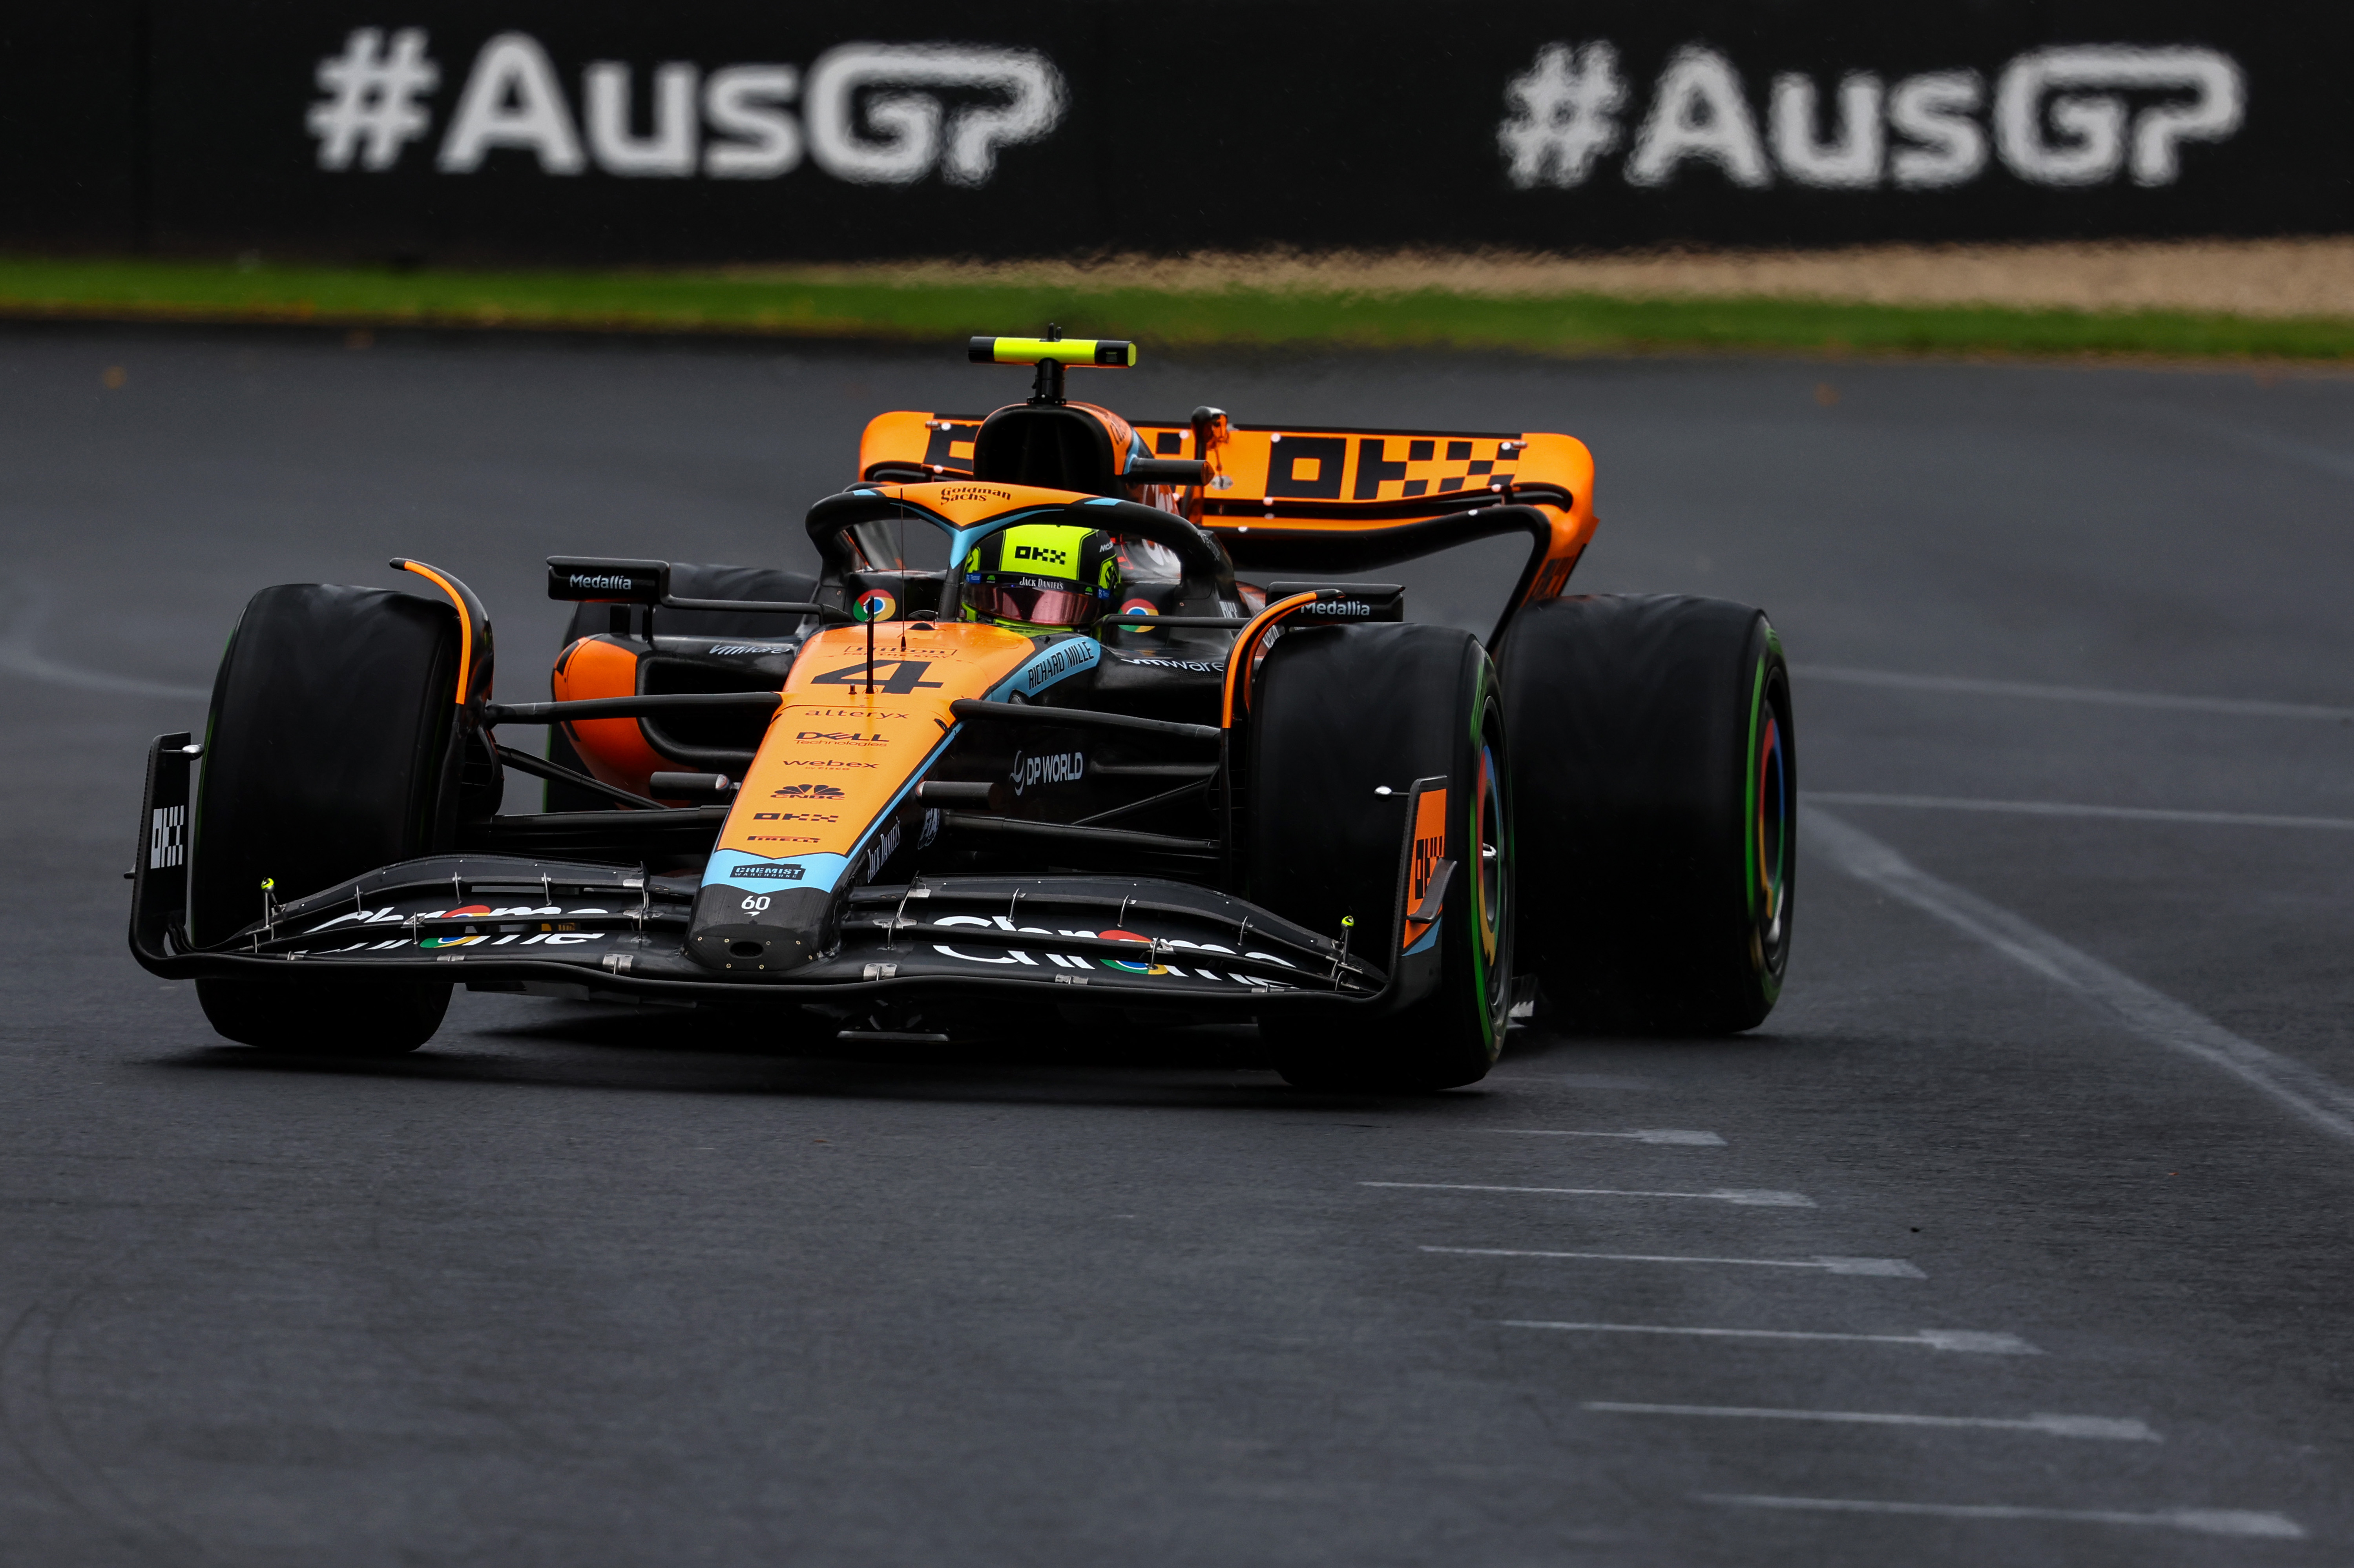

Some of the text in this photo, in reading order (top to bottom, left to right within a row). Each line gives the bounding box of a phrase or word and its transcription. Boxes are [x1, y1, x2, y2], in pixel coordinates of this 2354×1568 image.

[305, 27, 1069, 186] #AusGP
[1498, 40, 2244, 188] #AusGP
[1265, 436, 1520, 500] OKX
[941, 493, 987, 505] Sachs
[942, 487, 1011, 500] Goldman
[1015, 546, 1066, 565] OKX
[570, 574, 631, 590] Medallia
[1301, 601, 1370, 615] Medallia
[1027, 641, 1094, 690] RICHARD MILLE
[1120, 659, 1224, 672] vmware
[811, 660, 944, 695] 4
[805, 709, 910, 719] alteryx
[796, 732, 889, 742] DELL
[783, 760, 880, 769] webex
[1027, 752, 1083, 785] DP WORLD
[753, 813, 839, 823] OKX
[741, 895, 771, 910] 60
